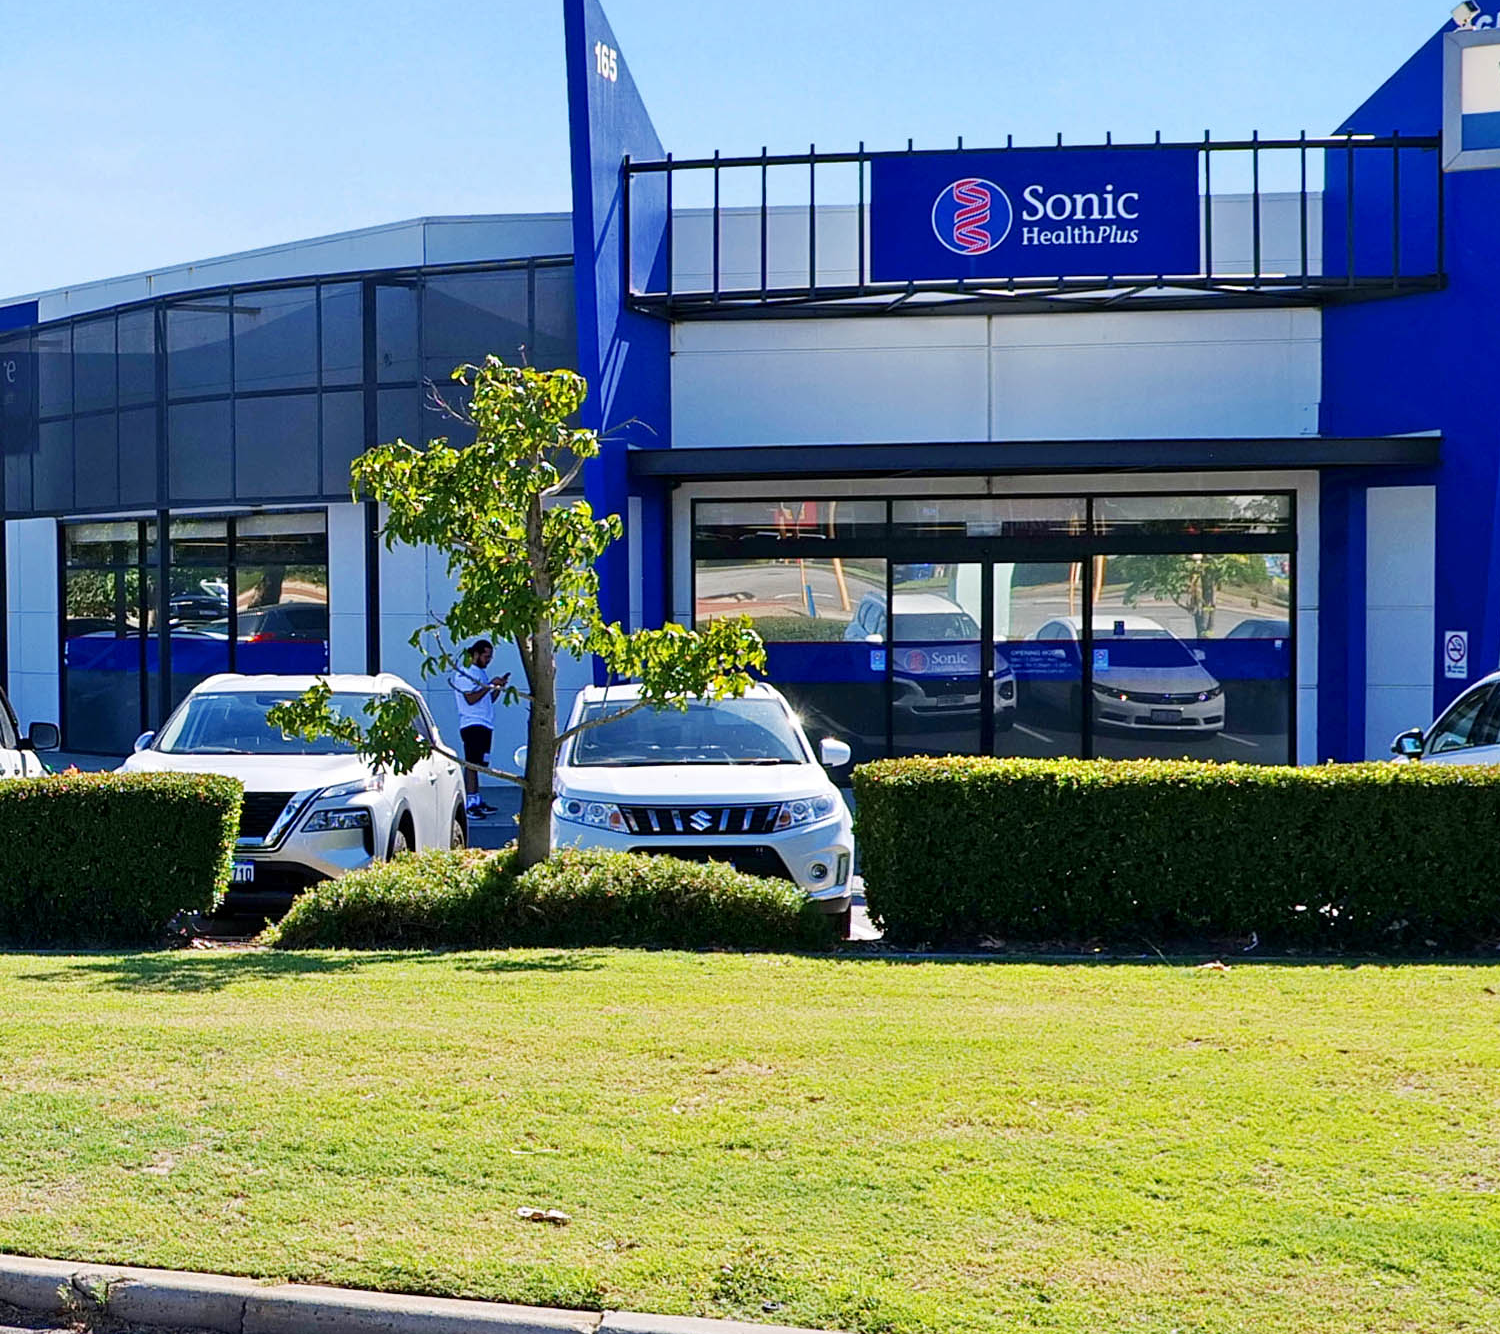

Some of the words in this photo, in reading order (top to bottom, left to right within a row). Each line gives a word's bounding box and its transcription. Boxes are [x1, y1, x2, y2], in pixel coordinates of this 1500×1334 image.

[594, 40, 618, 83] 165
[1022, 184, 1139, 221] Sonic
[1022, 225, 1139, 245] HealthPlus
[931, 651, 968, 665] Sonic
